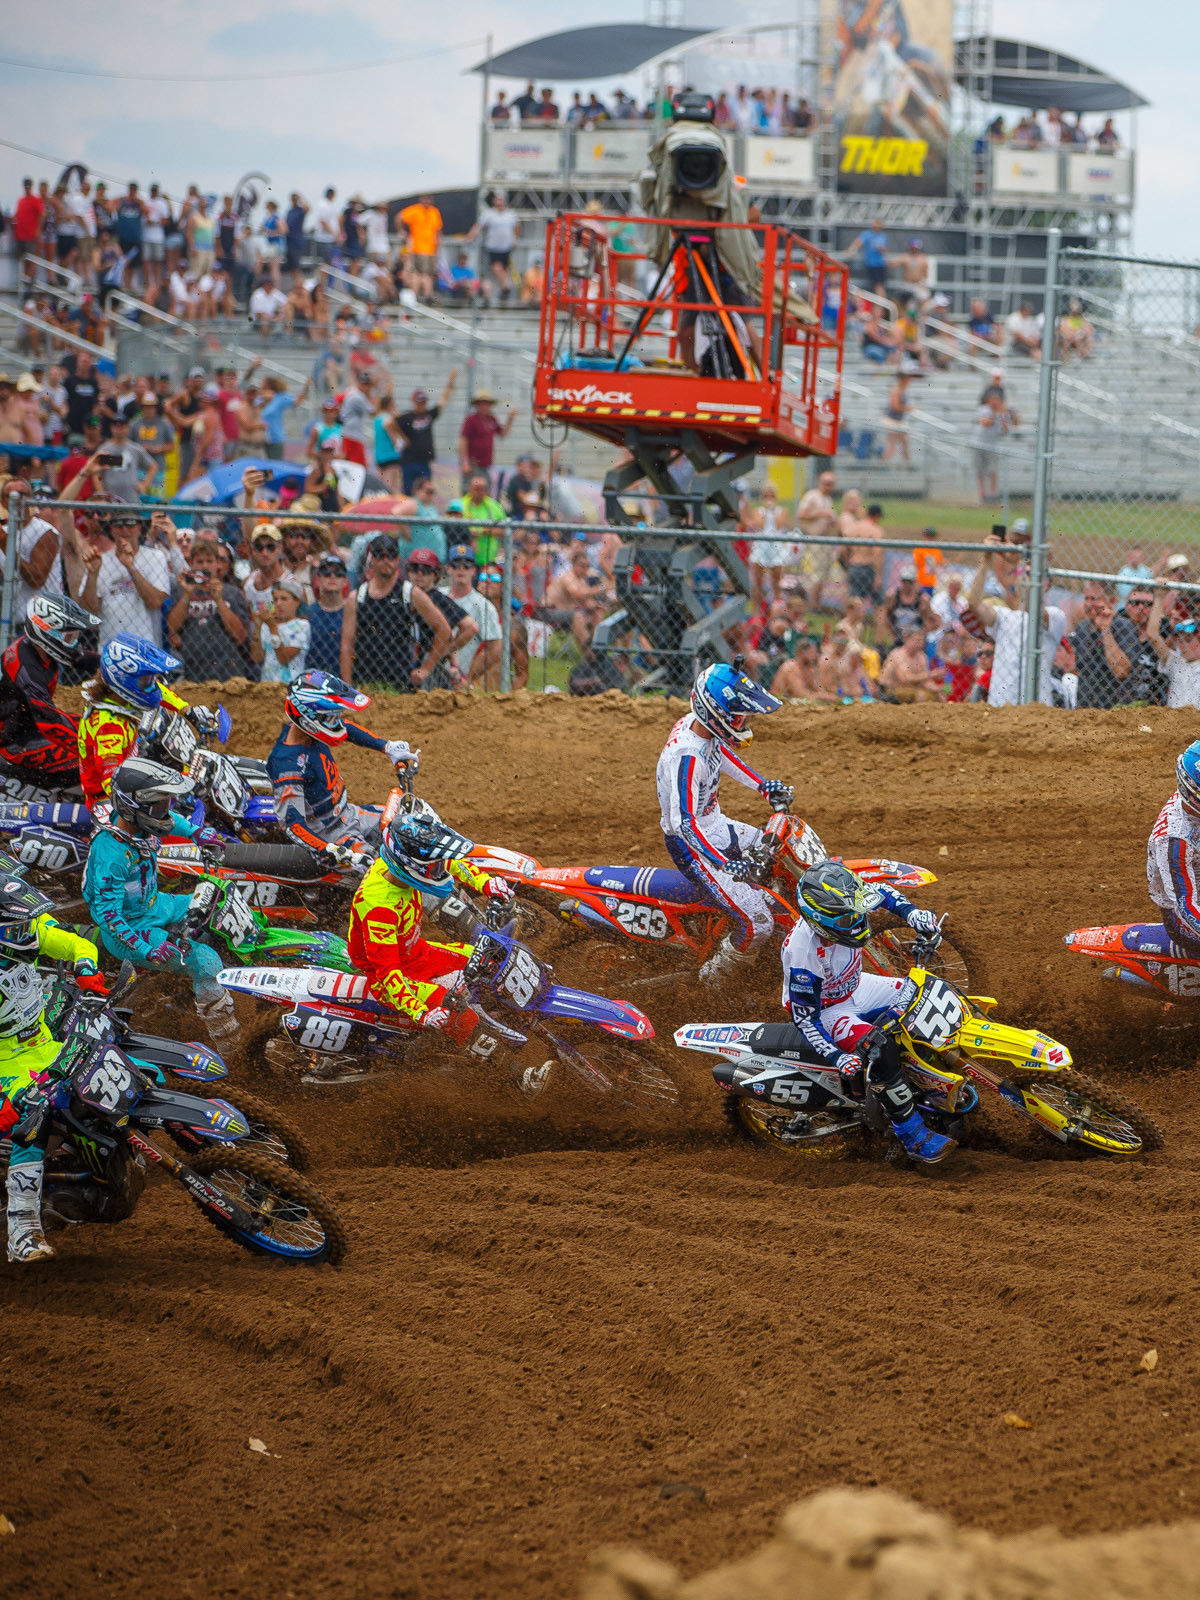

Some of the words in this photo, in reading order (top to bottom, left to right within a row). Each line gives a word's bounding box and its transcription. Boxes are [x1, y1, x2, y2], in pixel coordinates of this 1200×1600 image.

[841, 136, 929, 176] THOR
[547, 385, 633, 404] SKYJACK
[20, 840, 69, 869] 610
[864, 894, 880, 905] Arai
[617, 902, 668, 938] 233
[505, 949, 541, 1008] 89
[913, 996, 928, 1014] LUCAS
[923, 988, 931, 998] OIL
[914, 979, 962, 1048] 55
[300, 1015, 351, 1051] 89
[719, 1047, 741, 1057] PIRELLI
[751, 1059, 765, 1067] KMC
[1021, 1060, 1042, 1068] JGR
[89, 1049, 131, 1110] 39
[771, 1079, 812, 1105] 55
